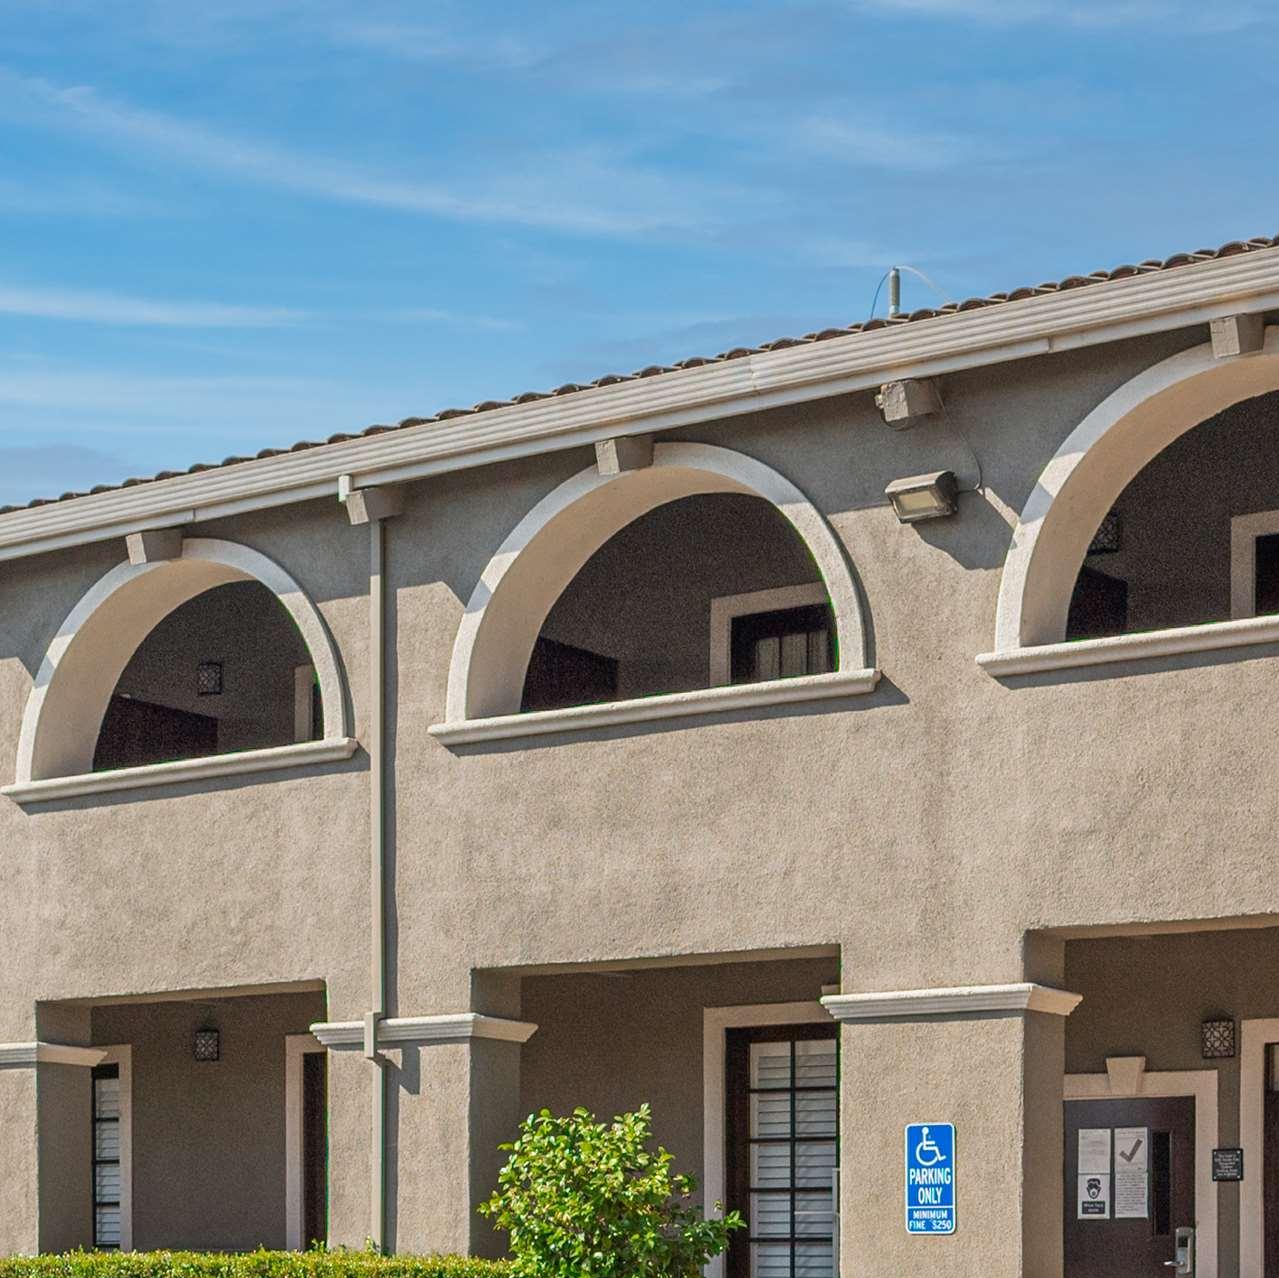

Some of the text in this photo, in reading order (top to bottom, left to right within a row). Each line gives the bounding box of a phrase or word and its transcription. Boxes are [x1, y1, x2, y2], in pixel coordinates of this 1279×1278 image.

[909, 1167, 952, 1185] PARKING
[917, 1186, 943, 1204] ONLY
[912, 1210, 948, 1219] MINIMUM
[909, 1220, 926, 1230] FINE
